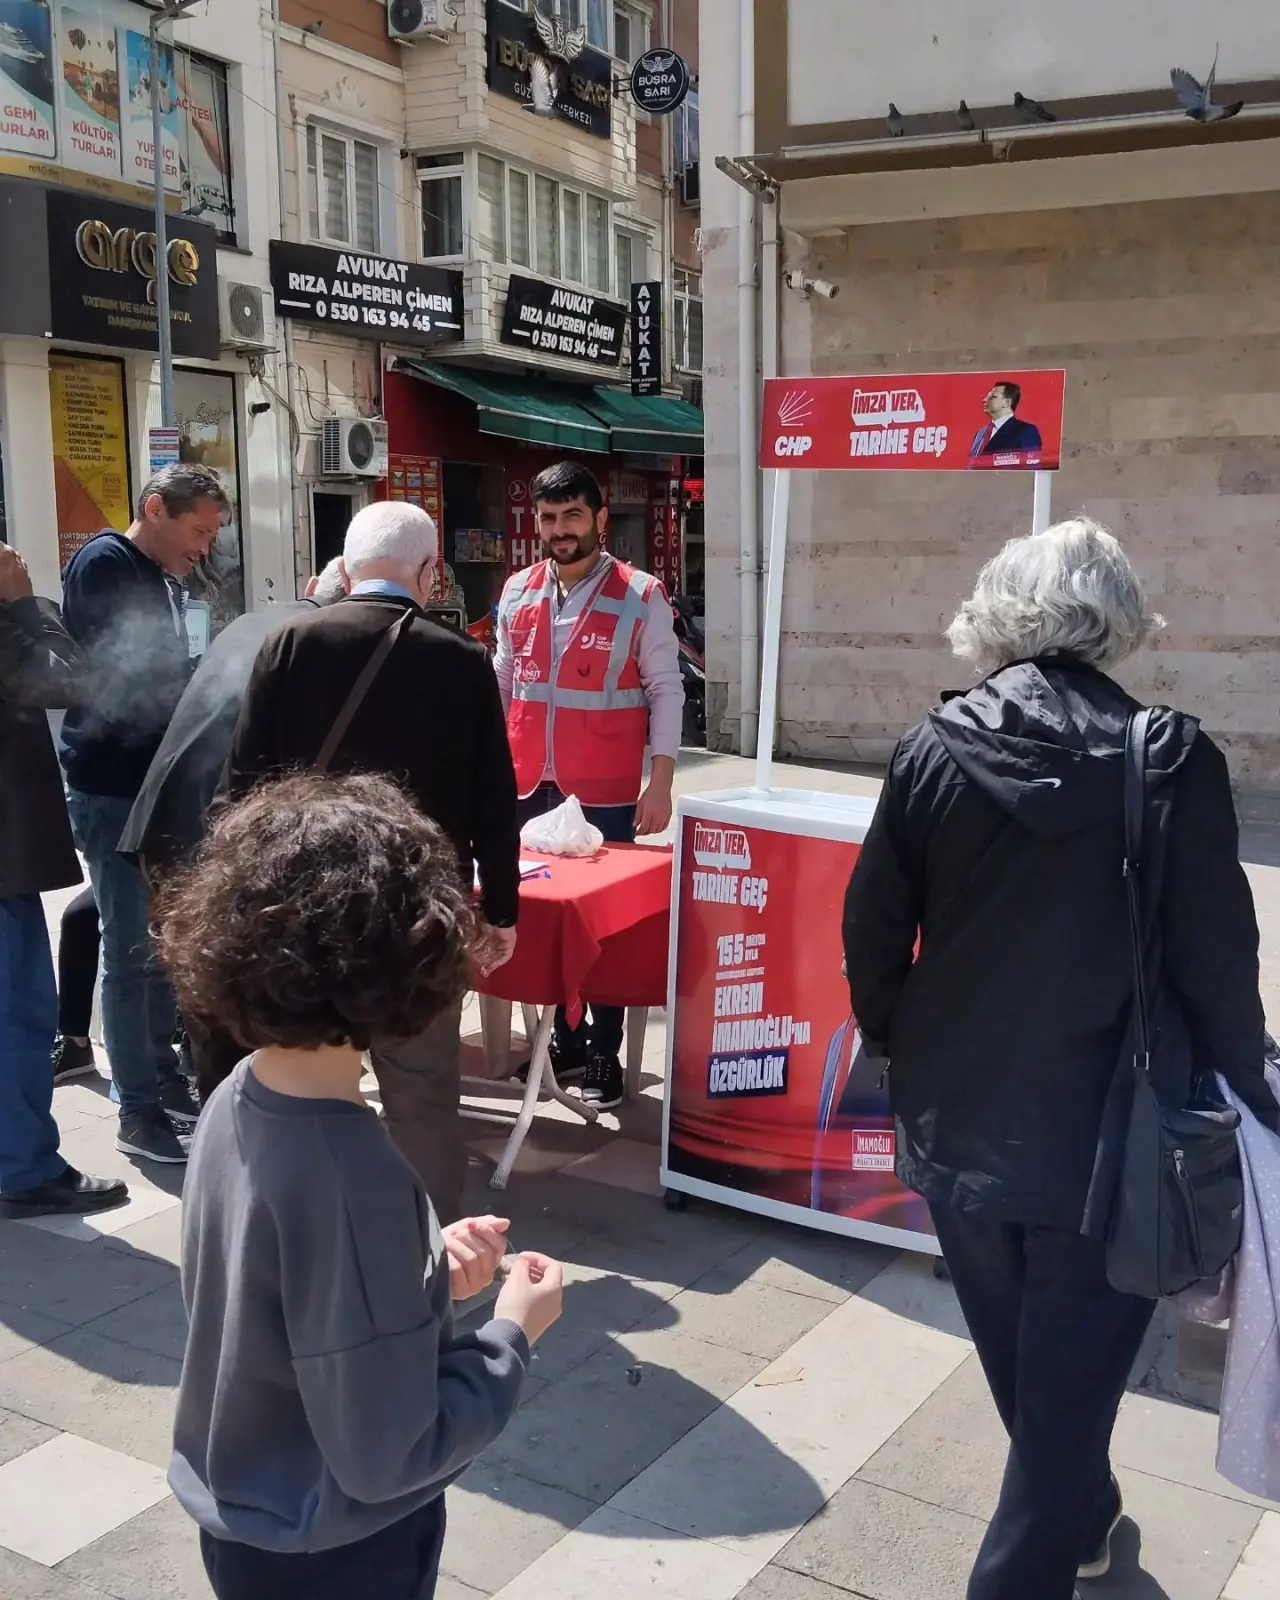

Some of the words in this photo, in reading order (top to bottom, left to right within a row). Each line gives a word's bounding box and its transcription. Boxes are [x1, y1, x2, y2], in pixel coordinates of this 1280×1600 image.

[638, 73, 676, 87] BÜŞRA
[644, 86, 670, 97] SARI
[3, 105, 37, 121] GEMİ
[0, 121, 50, 142] URLARI
[72, 119, 114, 143] KÜLTÜR
[71, 136, 116, 160] TURLARI
[336, 254, 409, 283] AVUKAT
[288, 272, 328, 295] RIZA
[331, 280, 403, 306] ALPEREN
[405, 287, 452, 313] ÇİMEN
[550, 289, 594, 315] AVUKAT
[315, 300, 327, 318] 0
[330, 302, 359, 322] 530
[361, 306, 387, 326] 163
[389, 310, 409, 329] 94
[412, 315, 431, 332] 45
[520, 304, 543, 325] RIZA
[544, 311, 586, 335] ALPEREN
[587, 317, 615, 342] ÇİMEN
[637, 285, 651, 376] AVUKAT
[531, 332, 540, 345] 0
[540, 334, 558, 349] 530
[559, 337, 573, 352] 163
[574, 340, 586, 356] 94
[586, 343, 599, 359] 45
[852, 390, 887, 415] İMZA
[890, 391, 920, 414] VER,
[774, 435, 813, 456] CHP
[850, 427, 908, 457] TARİHE
[912, 425, 948, 458] GEÇ
[695, 824, 721, 853] İMZA
[725, 831, 747, 860] VER,
[692, 872, 739, 905] TARİHE
[741, 876, 768, 914] GEÇ
[714, 982, 764, 1017] EKREM
[709, 1056, 786, 1092] ÖZGÜRLÜK
[857, 1134, 891, 1153] İMAMOĞLU
